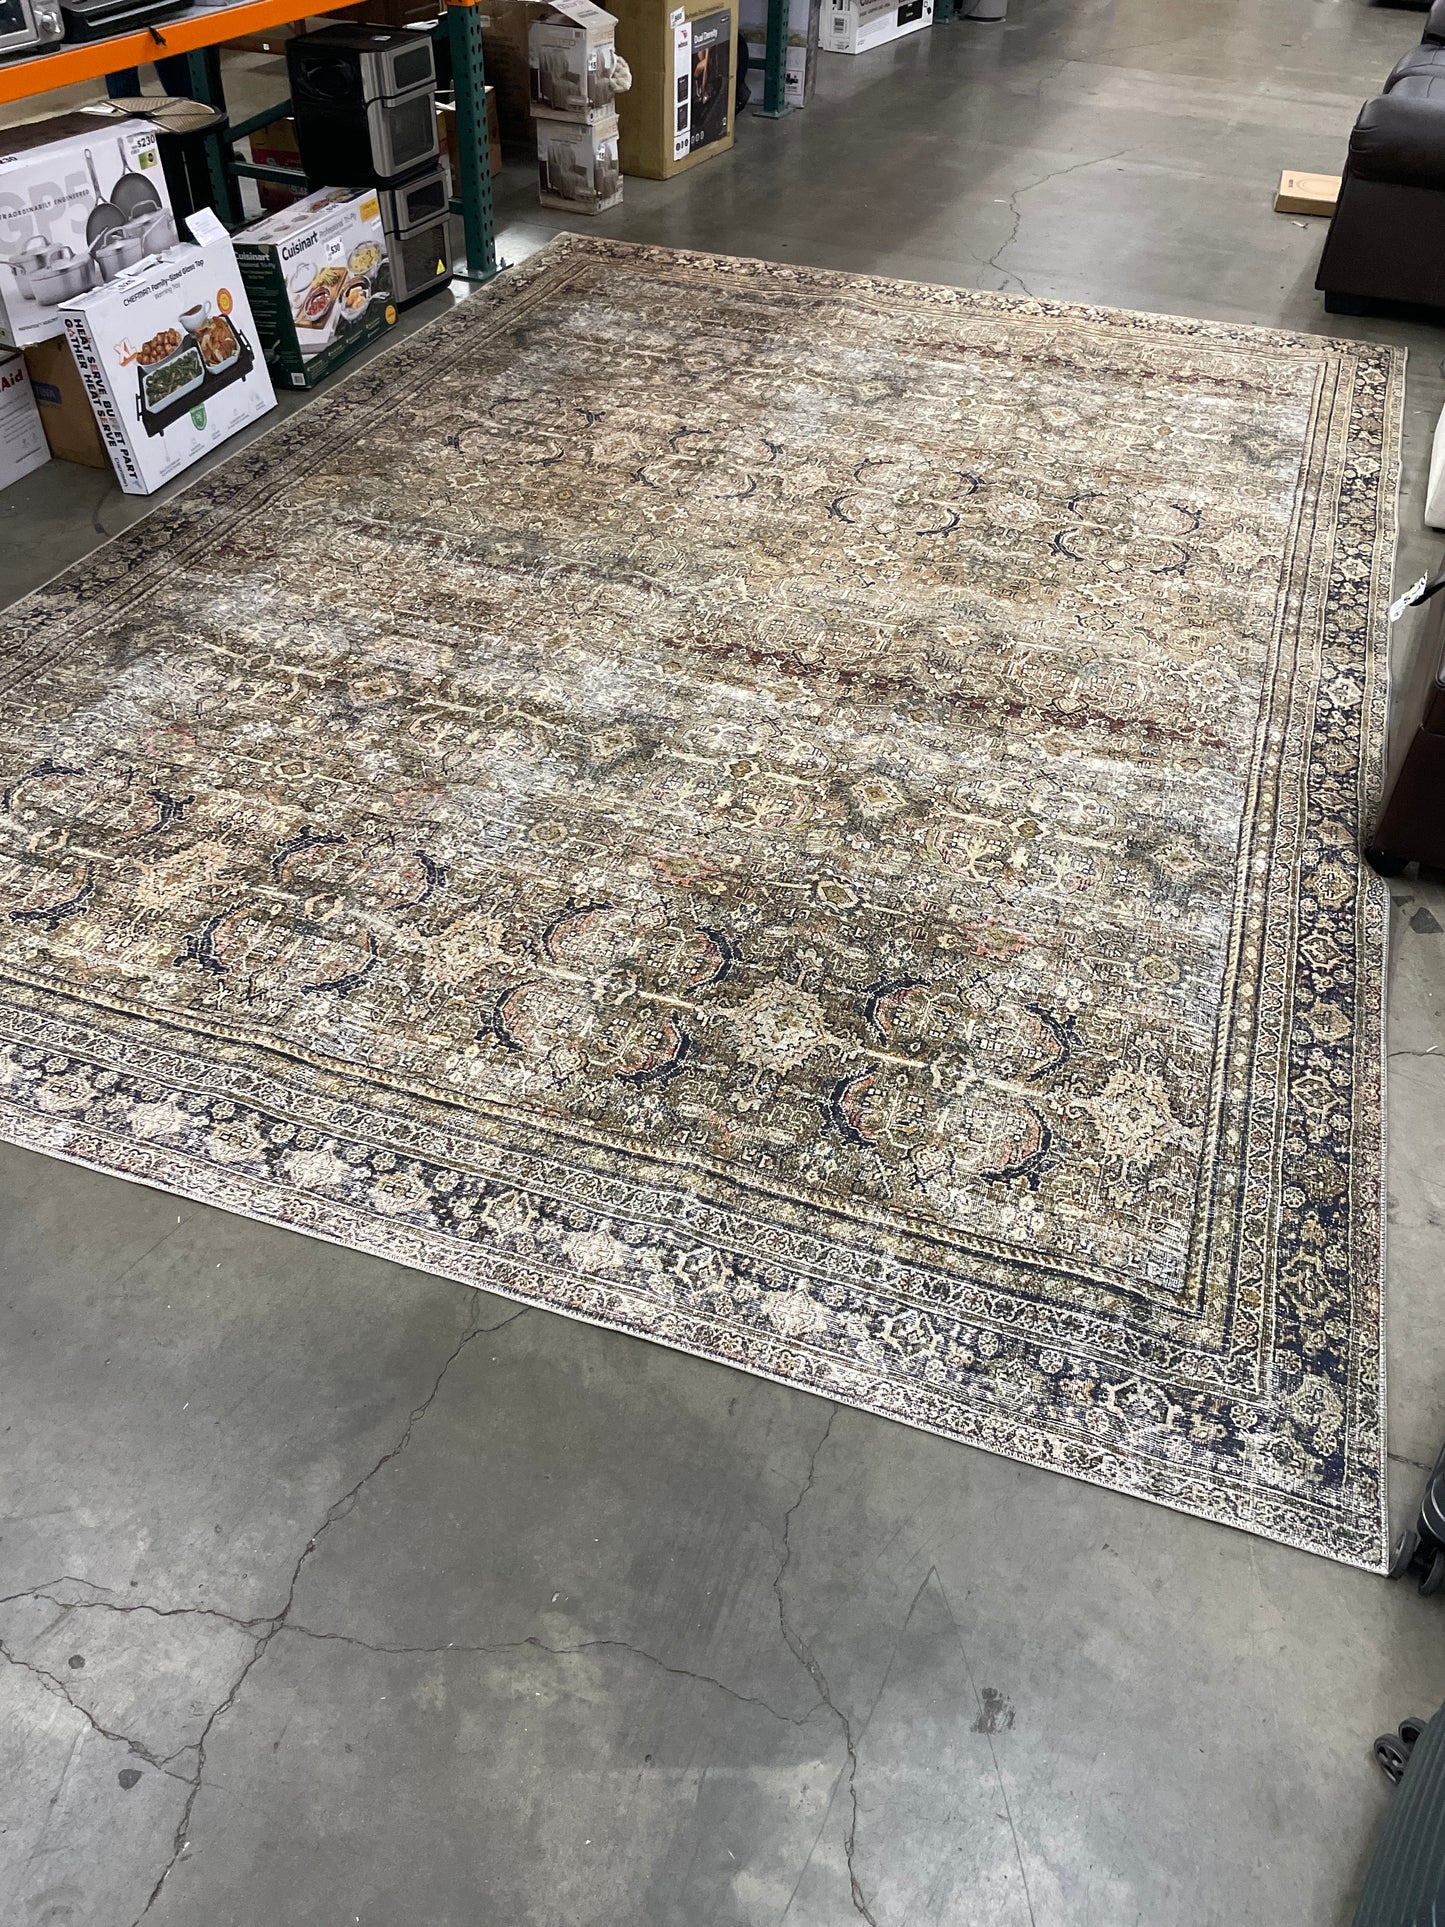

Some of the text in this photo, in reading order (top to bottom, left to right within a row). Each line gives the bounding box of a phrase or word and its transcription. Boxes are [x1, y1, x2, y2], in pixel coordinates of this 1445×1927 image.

[136, 134, 155, 148] $230
[0, 201, 52, 220] RAORDINARILY
[235, 251, 270, 262] Cuisinart
[281, 230, 319, 262] Cuisinart
[151, 270, 183, 294] Family-Sized
[182, 263, 196, 276] Glass
[194, 258, 205, 268] Top
[73, 318, 92, 352] HEAT
[87, 356, 108, 396] SERVE
[0, 369, 24, 392] Aid
[64, 318, 118, 447] GATHER HEAT SERVE
